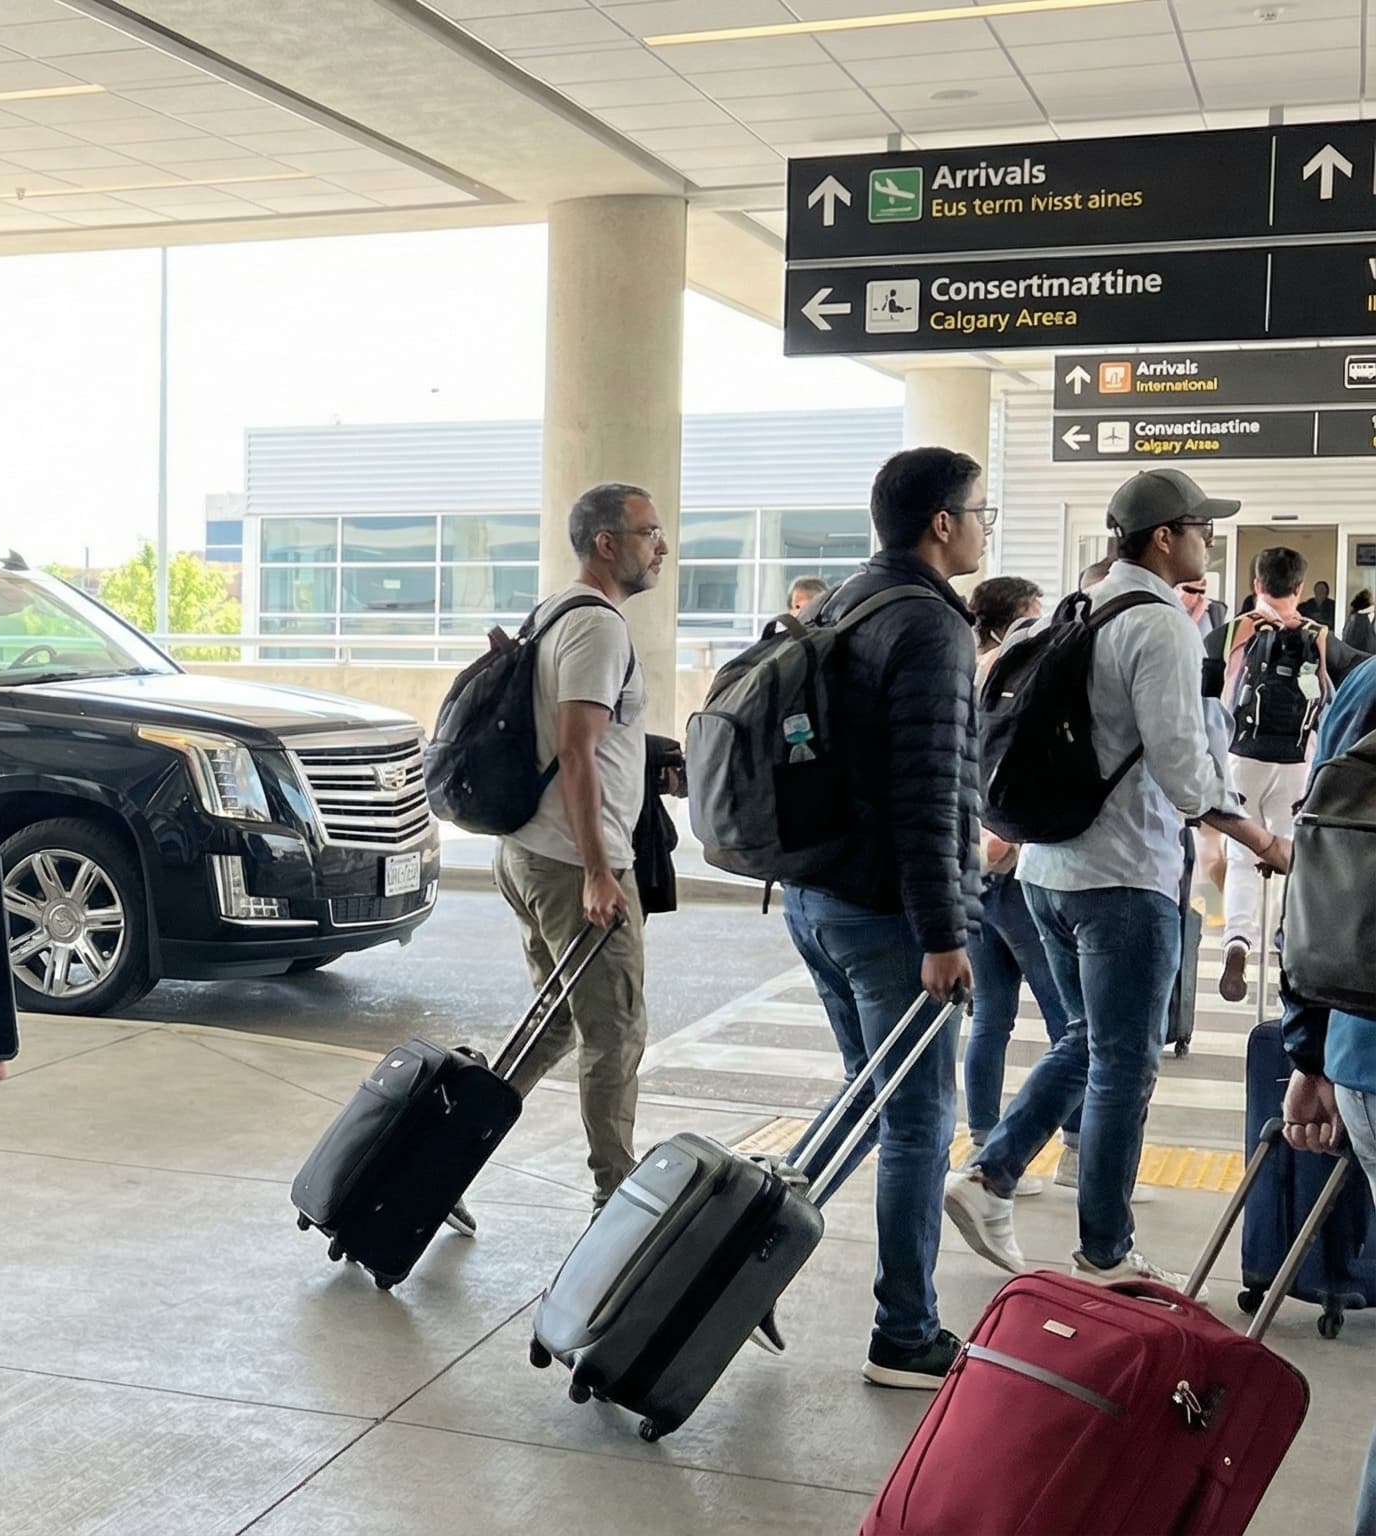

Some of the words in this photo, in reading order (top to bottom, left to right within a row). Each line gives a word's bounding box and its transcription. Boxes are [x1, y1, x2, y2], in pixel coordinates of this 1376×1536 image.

[931, 158, 1046, 190] Arrivals
[931, 199, 967, 218] Eus
[973, 198, 1023, 216] term
[1087, 189, 1143, 209] aines
[930, 311, 1010, 333] Calgary
[1135, 359, 1199, 376] Arrivals
